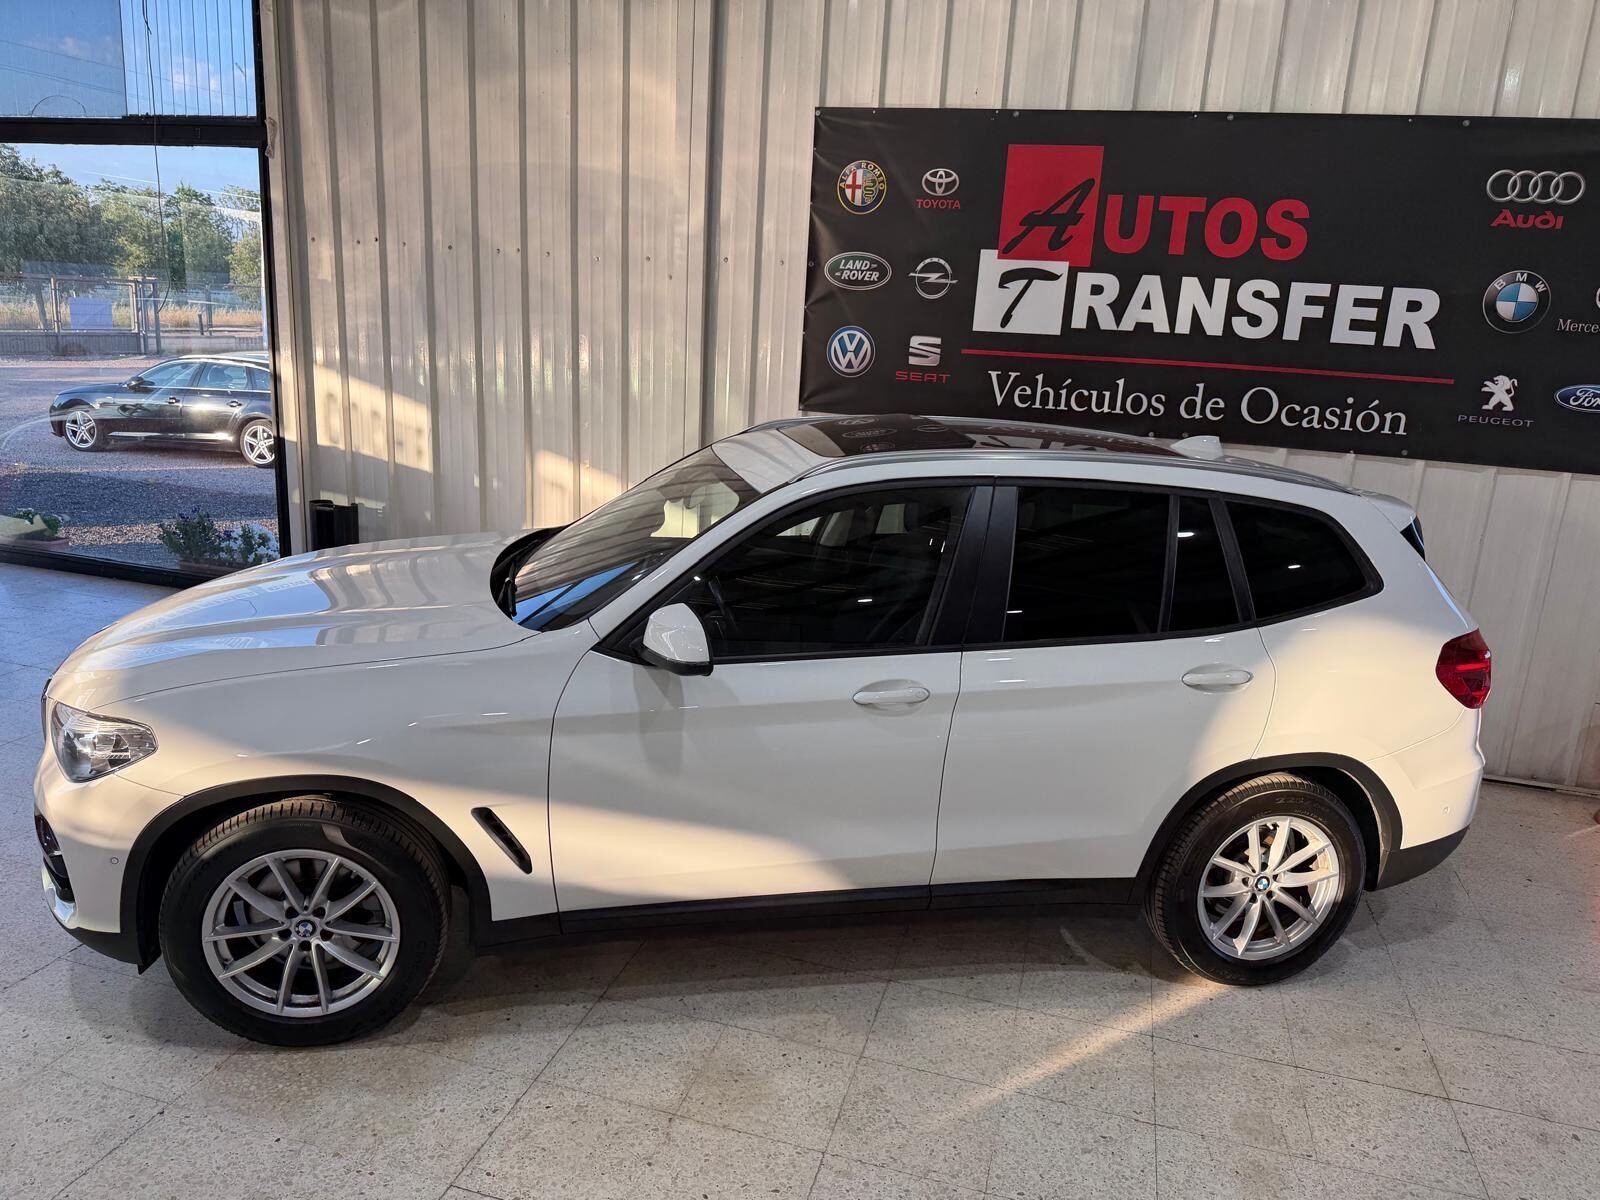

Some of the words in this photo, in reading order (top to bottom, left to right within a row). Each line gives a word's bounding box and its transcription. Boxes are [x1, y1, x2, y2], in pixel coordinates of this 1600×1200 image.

[861, 162, 886, 190] ROMEO
[916, 198, 961, 209] TOYOTA
[1003, 177, 1310, 261] AUTOS
[1490, 208, 1564, 230] Audi
[839, 259, 870, 271] LAND
[841, 270, 880, 282] ROVER
[1493, 272, 1548, 294] BMW
[999, 268, 1441, 350] TRANSFER
[1556, 318, 1600, 333] Merce
[895, 371, 951, 384] SEAT
[988, 370, 1166, 418] Vehículos
[1179, 383, 1225, 422] de
[1240, 386, 1408, 436] Ocasión
[1569, 387, 1600, 408] For
[1457, 414, 1535, 428] PEUGEOT
